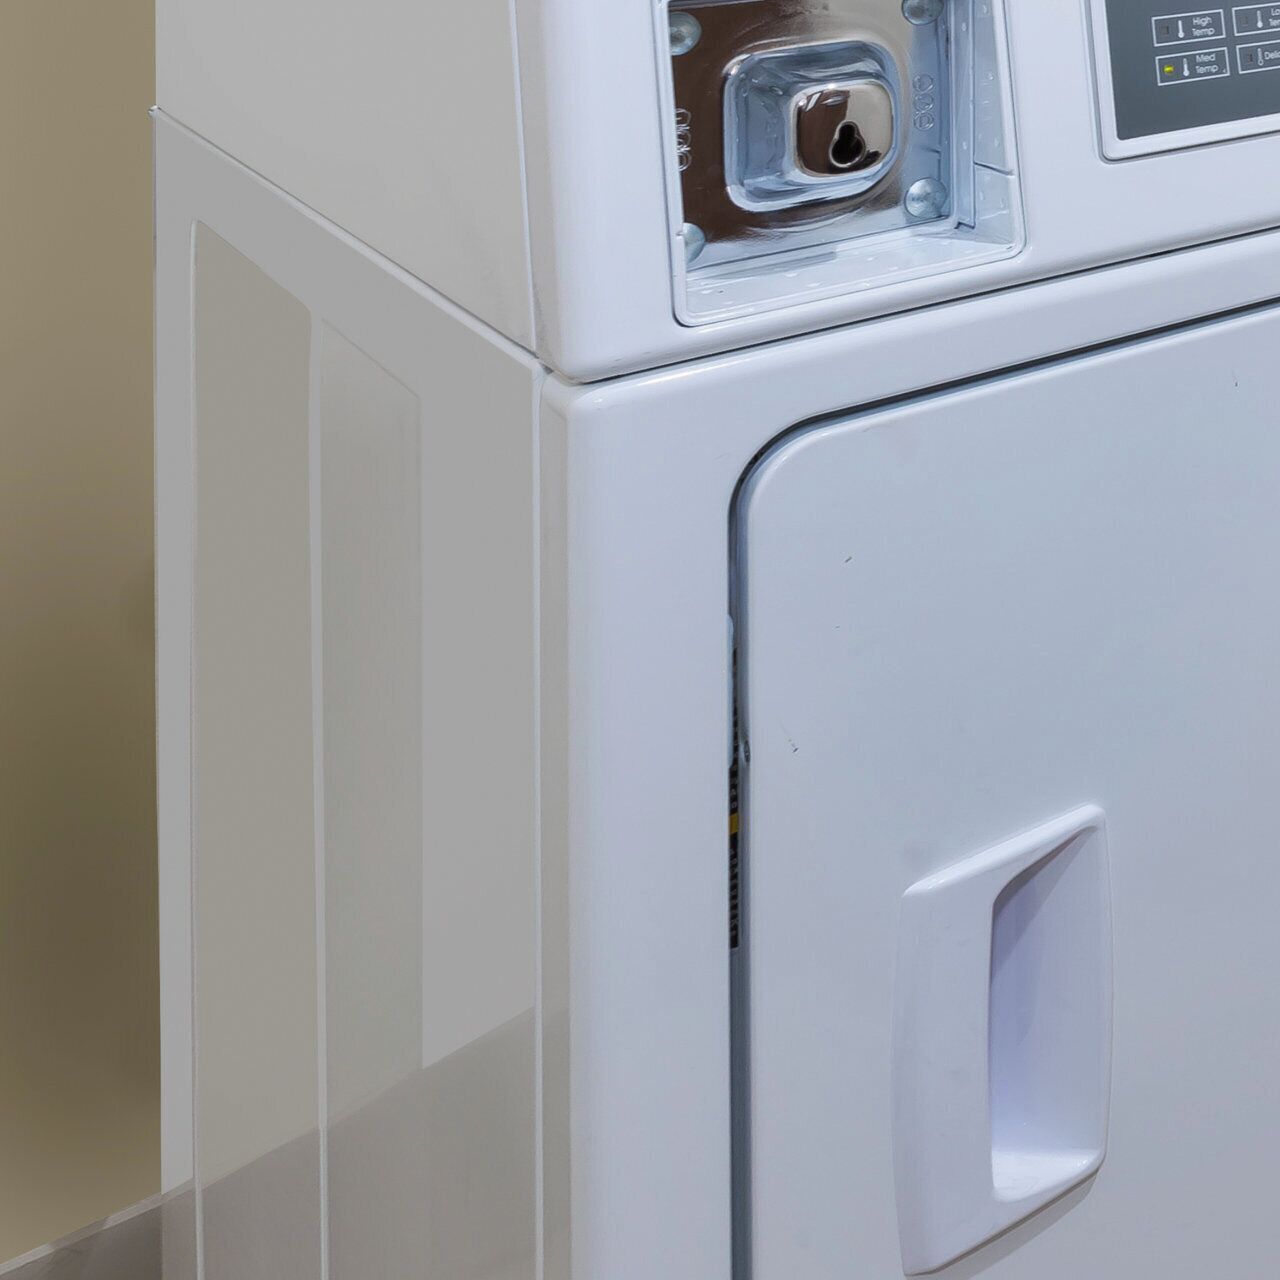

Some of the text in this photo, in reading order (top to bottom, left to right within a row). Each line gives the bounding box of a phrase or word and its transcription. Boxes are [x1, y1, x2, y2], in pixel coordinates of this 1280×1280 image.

[1192, 16, 1212, 27] High
[1192, 27, 1215, 37] Temp
[1196, 53, 1216, 63] Med
[1195, 64, 1219, 75] Temp
